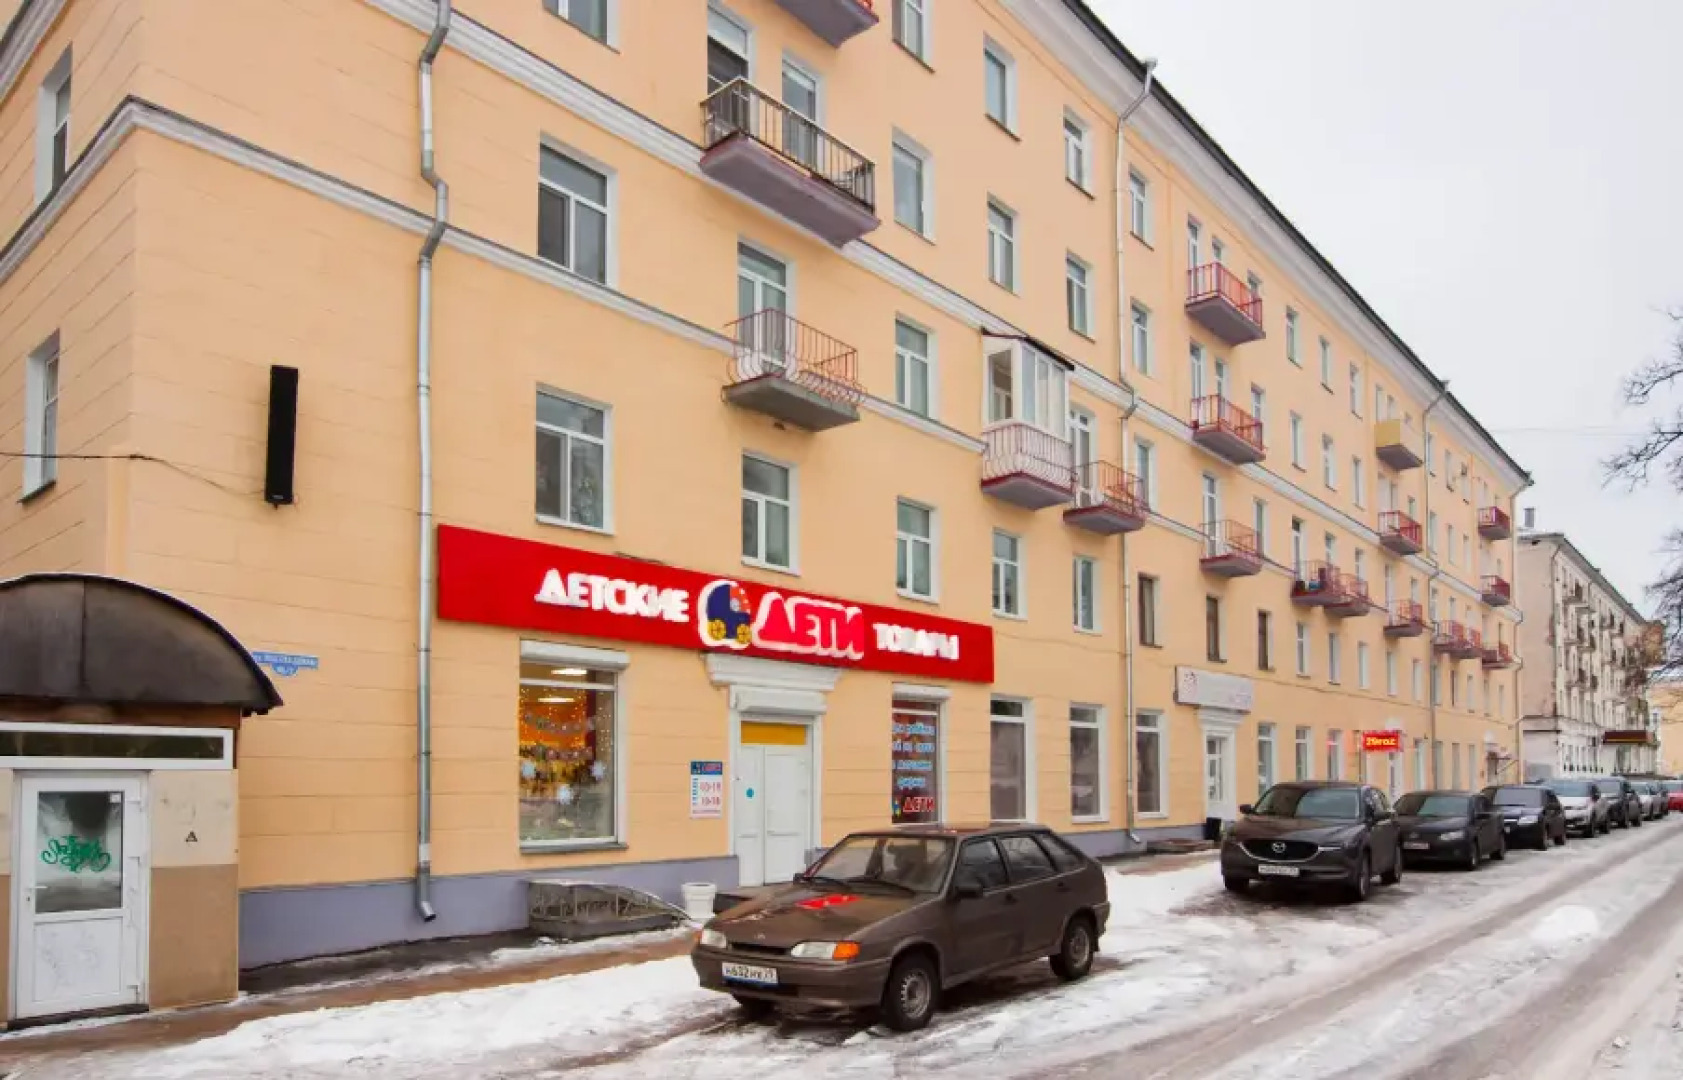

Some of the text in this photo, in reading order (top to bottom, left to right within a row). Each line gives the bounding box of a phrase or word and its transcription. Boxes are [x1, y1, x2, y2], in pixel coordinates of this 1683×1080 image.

[534, 568, 690, 623] ДЕТСКИЕ
[753, 592, 865, 658] ДЕТИ
[872, 622, 960, 661] ТОВАРЫ
[902, 796, 935, 813] ДЕТИ
